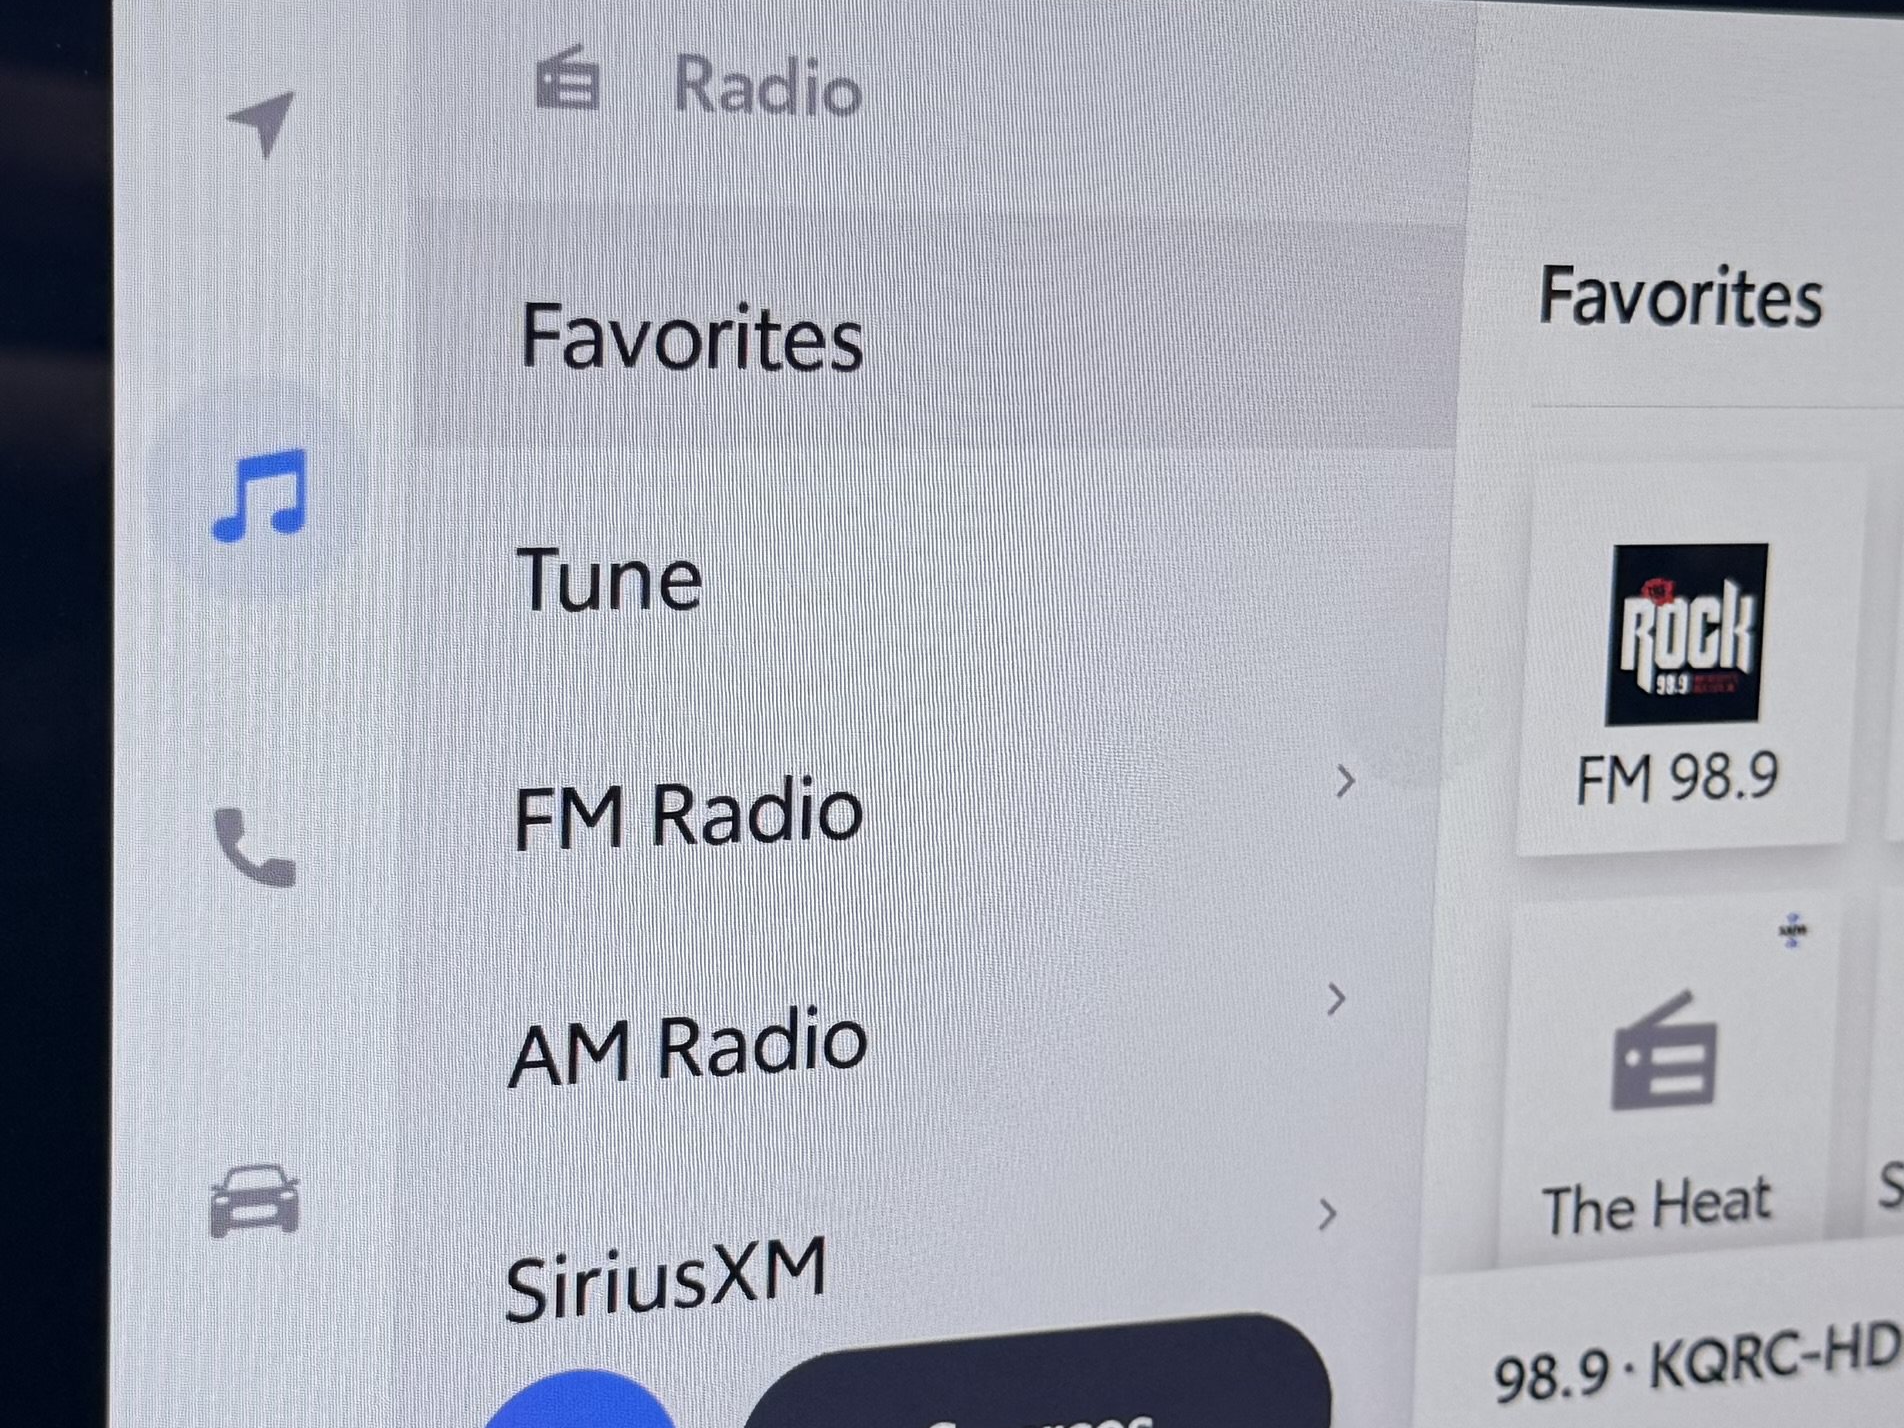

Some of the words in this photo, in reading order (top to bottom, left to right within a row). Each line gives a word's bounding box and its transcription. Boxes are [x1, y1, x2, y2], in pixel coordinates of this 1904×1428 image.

[674, 52, 864, 120] Radio
[1540, 264, 1825, 330] Favorites
[522, 302, 865, 372] Favorites
[517, 548, 703, 612] Tune
[1656, 673, 1689, 695] 98.9
[1577, 755, 1652, 806] FM
[1672, 749, 1779, 802] 98.9
[517, 786, 622, 853] FM
[651, 774, 864, 847] Radio
[507, 1021, 631, 1090] AM
[658, 1005, 868, 1079] Radio
[1543, 1184, 1638, 1238] The
[1653, 1176, 1773, 1230] Heat
[505, 1236, 827, 1324] SiriusXM
[1494, 1351, 1611, 1404] 98.9
[1650, 1319, 1904, 1391] KQRC-HD
